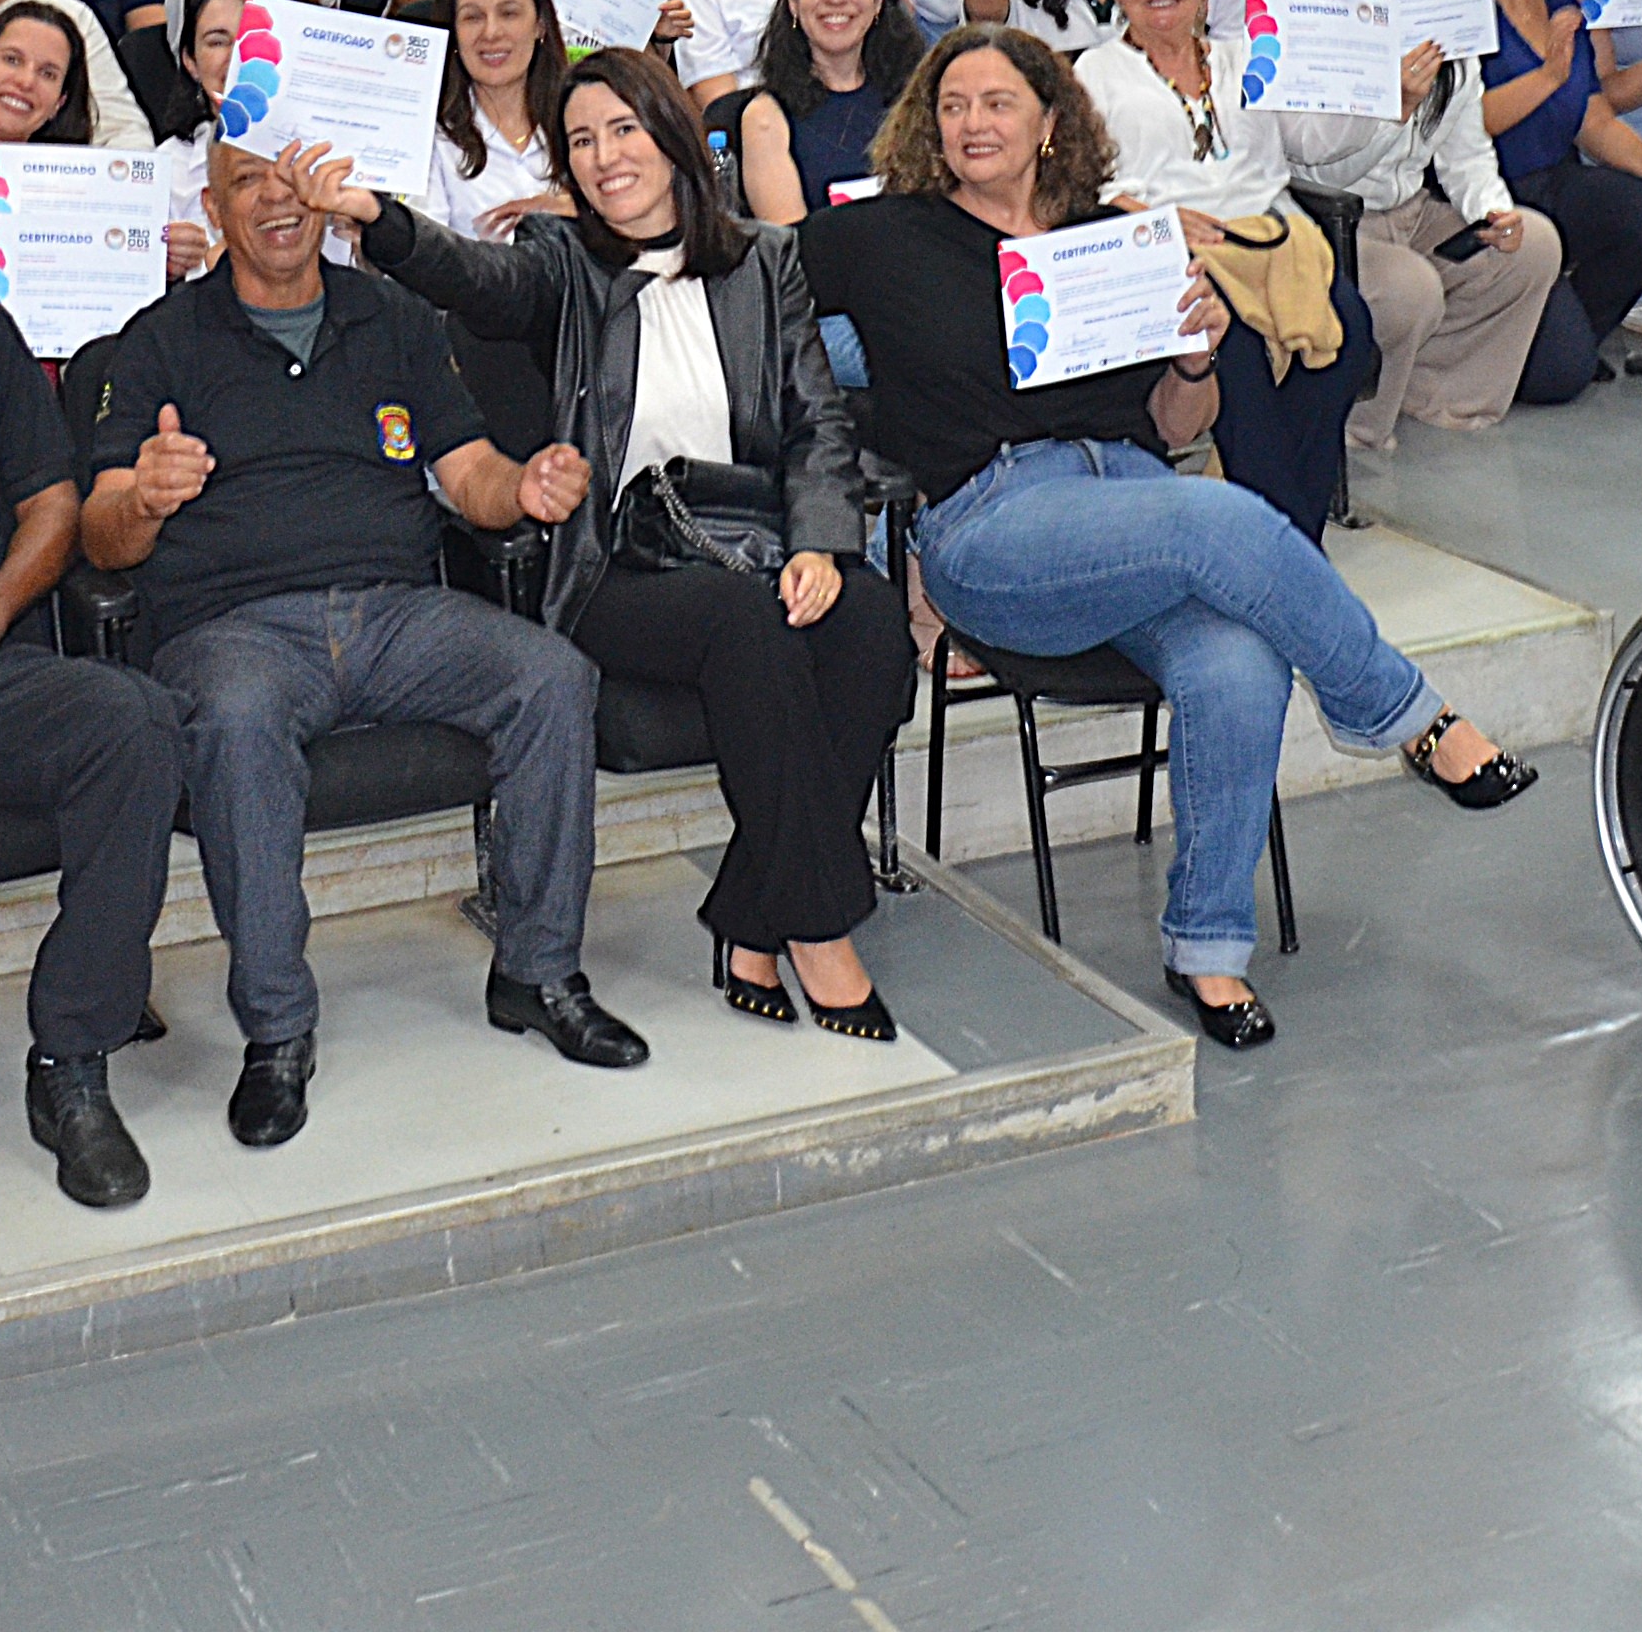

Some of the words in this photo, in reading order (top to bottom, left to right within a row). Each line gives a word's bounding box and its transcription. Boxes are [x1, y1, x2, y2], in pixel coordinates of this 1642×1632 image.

[1289, 4, 1349, 17] CERTIFICADO
[303, 27, 375, 49] CERTIFICADO
[407, 35, 430, 48] SELO
[406, 46, 428, 60] ODS
[23, 164, 97, 176] CERTIFICADO
[132, 161, 155, 171] SELO
[131, 170, 155, 181] ODS
[19, 234, 93, 244] CERTIFICADO
[128, 229, 150, 238] SELO
[127, 238, 150, 249] ODS
[1053, 239, 1123, 262] CERTIFICADO
